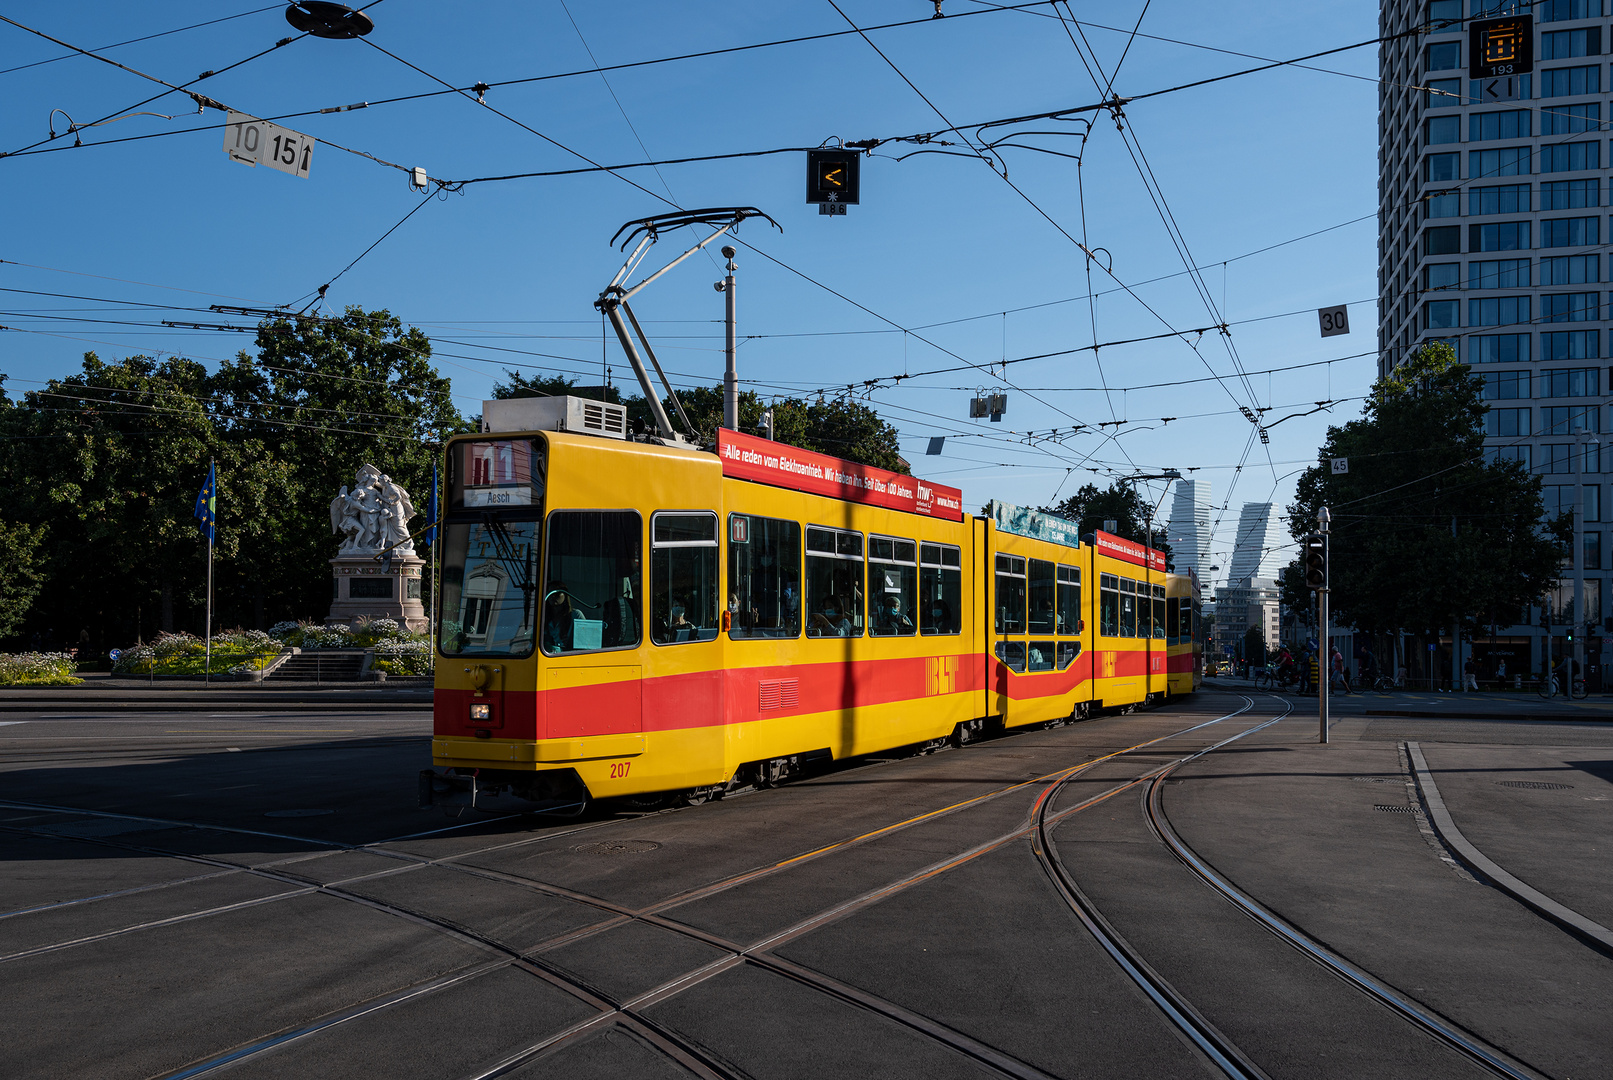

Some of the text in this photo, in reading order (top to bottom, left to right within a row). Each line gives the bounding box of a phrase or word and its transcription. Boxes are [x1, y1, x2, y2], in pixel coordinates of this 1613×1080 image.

[1491, 64, 1514, 76] 193
[235, 123, 260, 152] 10
[273, 134, 297, 165] 15
[822, 203, 845, 214] 186
[1322, 310, 1345, 331] 30
[725, 444, 740, 460] Alle
[742, 449, 762, 465] reden
[764, 455, 778, 468] vom
[824, 466, 835, 481] Wir
[834, 469, 853, 486] haben
[874, 478, 887, 493] über
[887, 482, 897, 496] 100
[1333, 460, 1347, 471] 45
[487, 491, 510, 504] Aesch
[734, 520, 744, 539] 11
[925, 655, 959, 697] BLT
[610, 761, 631, 779] 207
